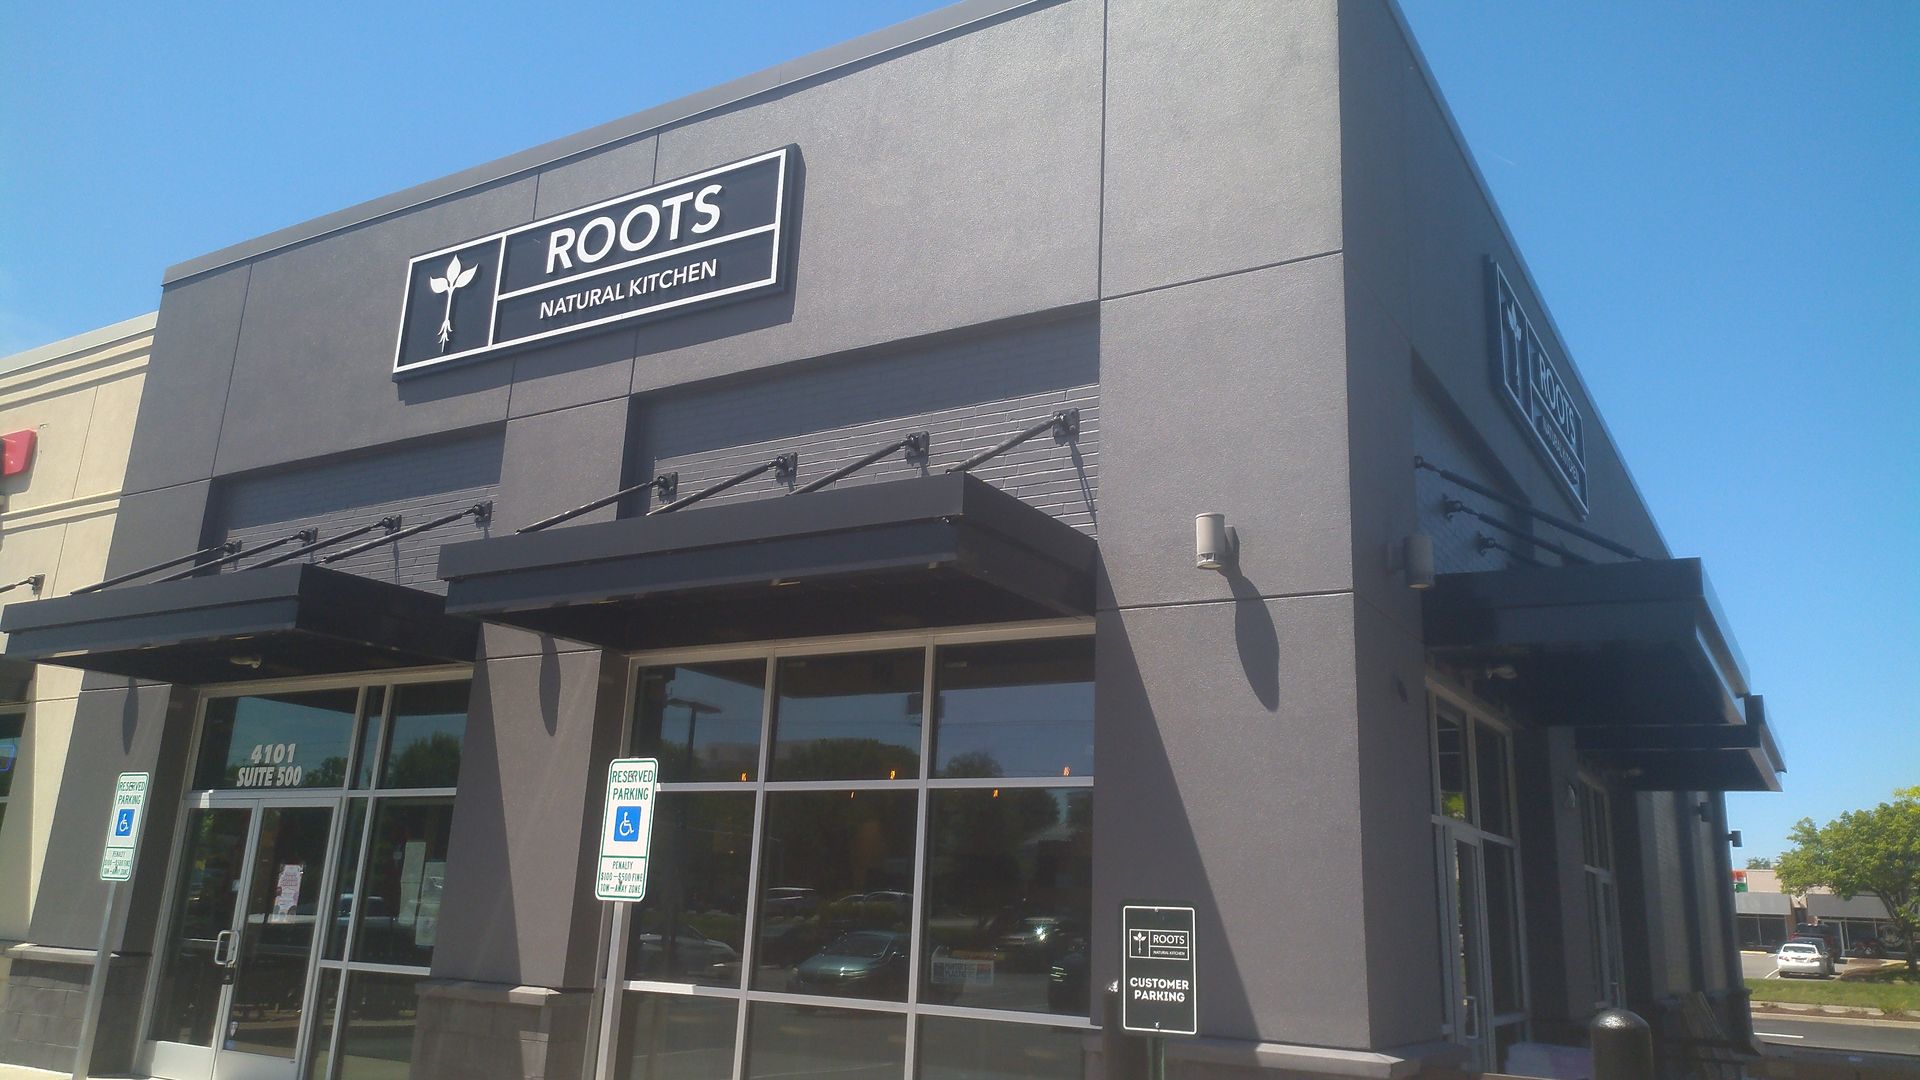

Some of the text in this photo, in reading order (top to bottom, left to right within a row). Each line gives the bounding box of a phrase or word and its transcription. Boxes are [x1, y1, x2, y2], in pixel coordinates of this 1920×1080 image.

[545, 184, 723, 274] ROOTS
[539, 258, 717, 320] NATURAL KITCHEN
[1539, 351, 1576, 447] ROOTS
[251, 743, 296, 764] 4101
[236, 765, 302, 787] SUITE 500
[611, 770, 654, 783] RESERVED
[117, 794, 142, 804] PARKING
[612, 787, 649, 800] PARKING
[612, 860, 634, 870] PENALTY
[1153, 934, 1185, 945] ROOTS
[1130, 977, 1190, 990] CUSTOMER
[1134, 989, 1186, 1003] PARKING
